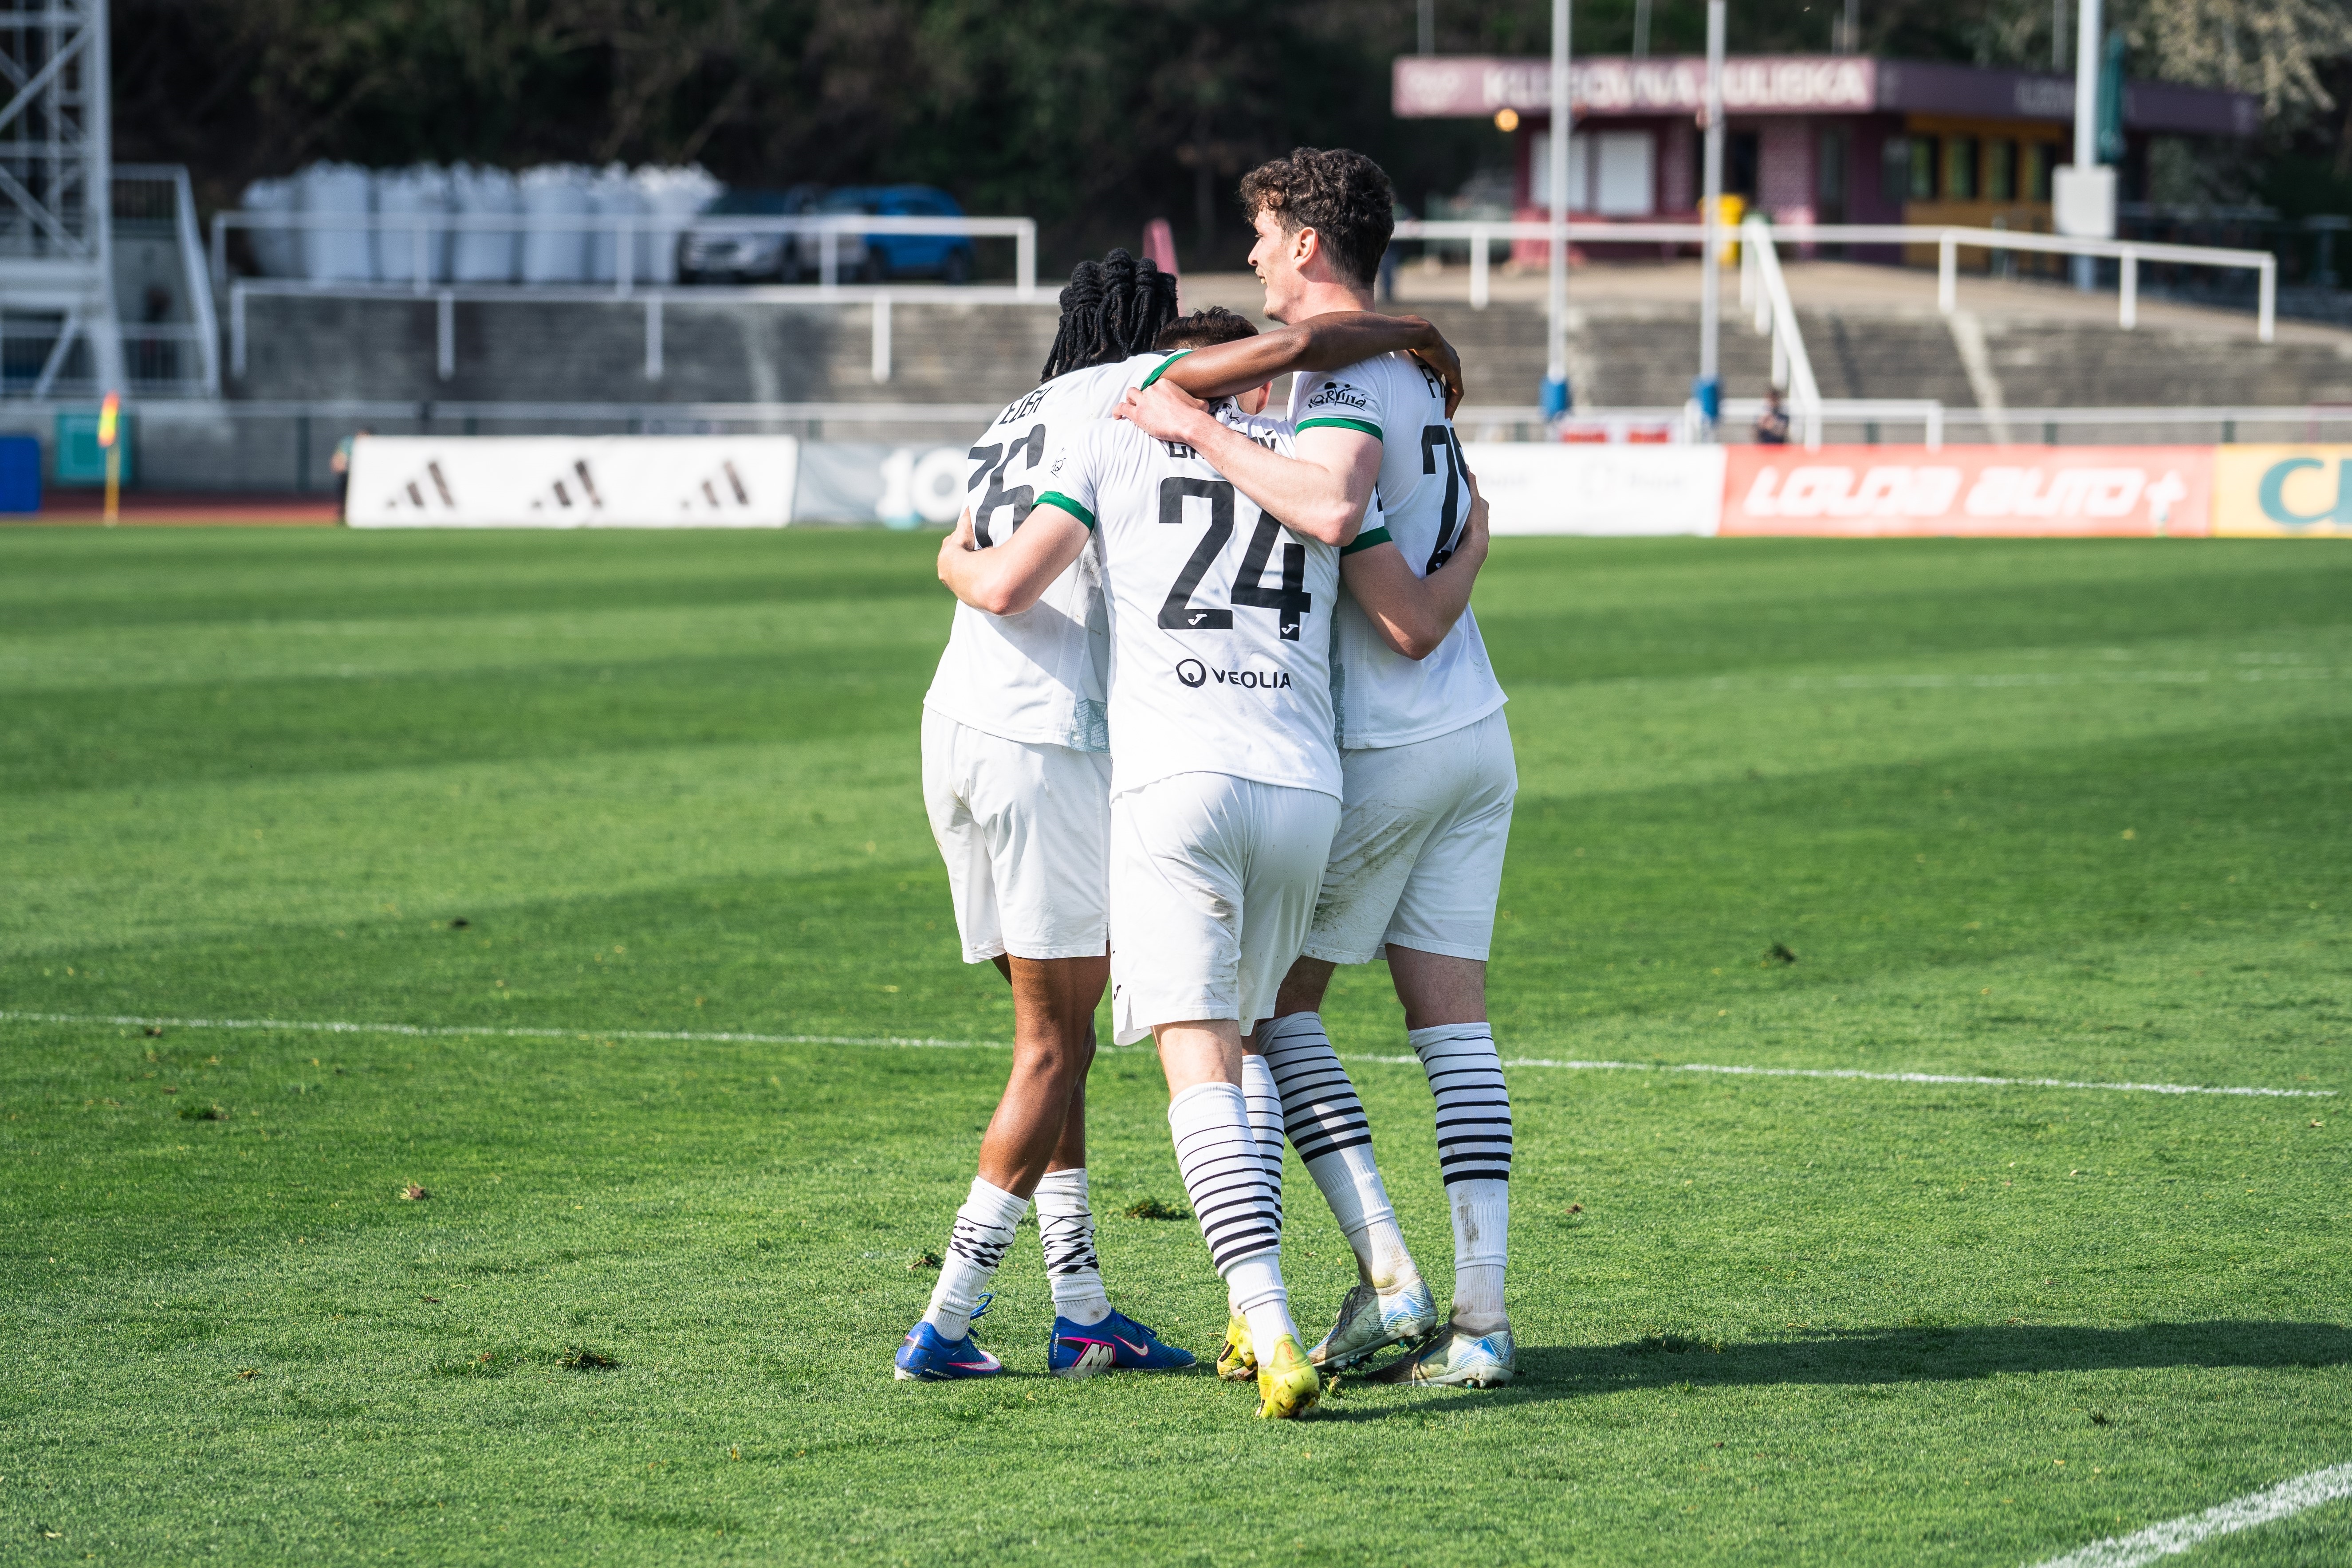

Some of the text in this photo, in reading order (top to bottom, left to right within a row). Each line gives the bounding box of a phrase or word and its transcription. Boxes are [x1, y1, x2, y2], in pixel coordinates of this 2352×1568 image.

[998, 386, 1054, 424] EZEH
[1157, 477, 1311, 641] 24
[1211, 667, 1292, 690] VEOLIA
